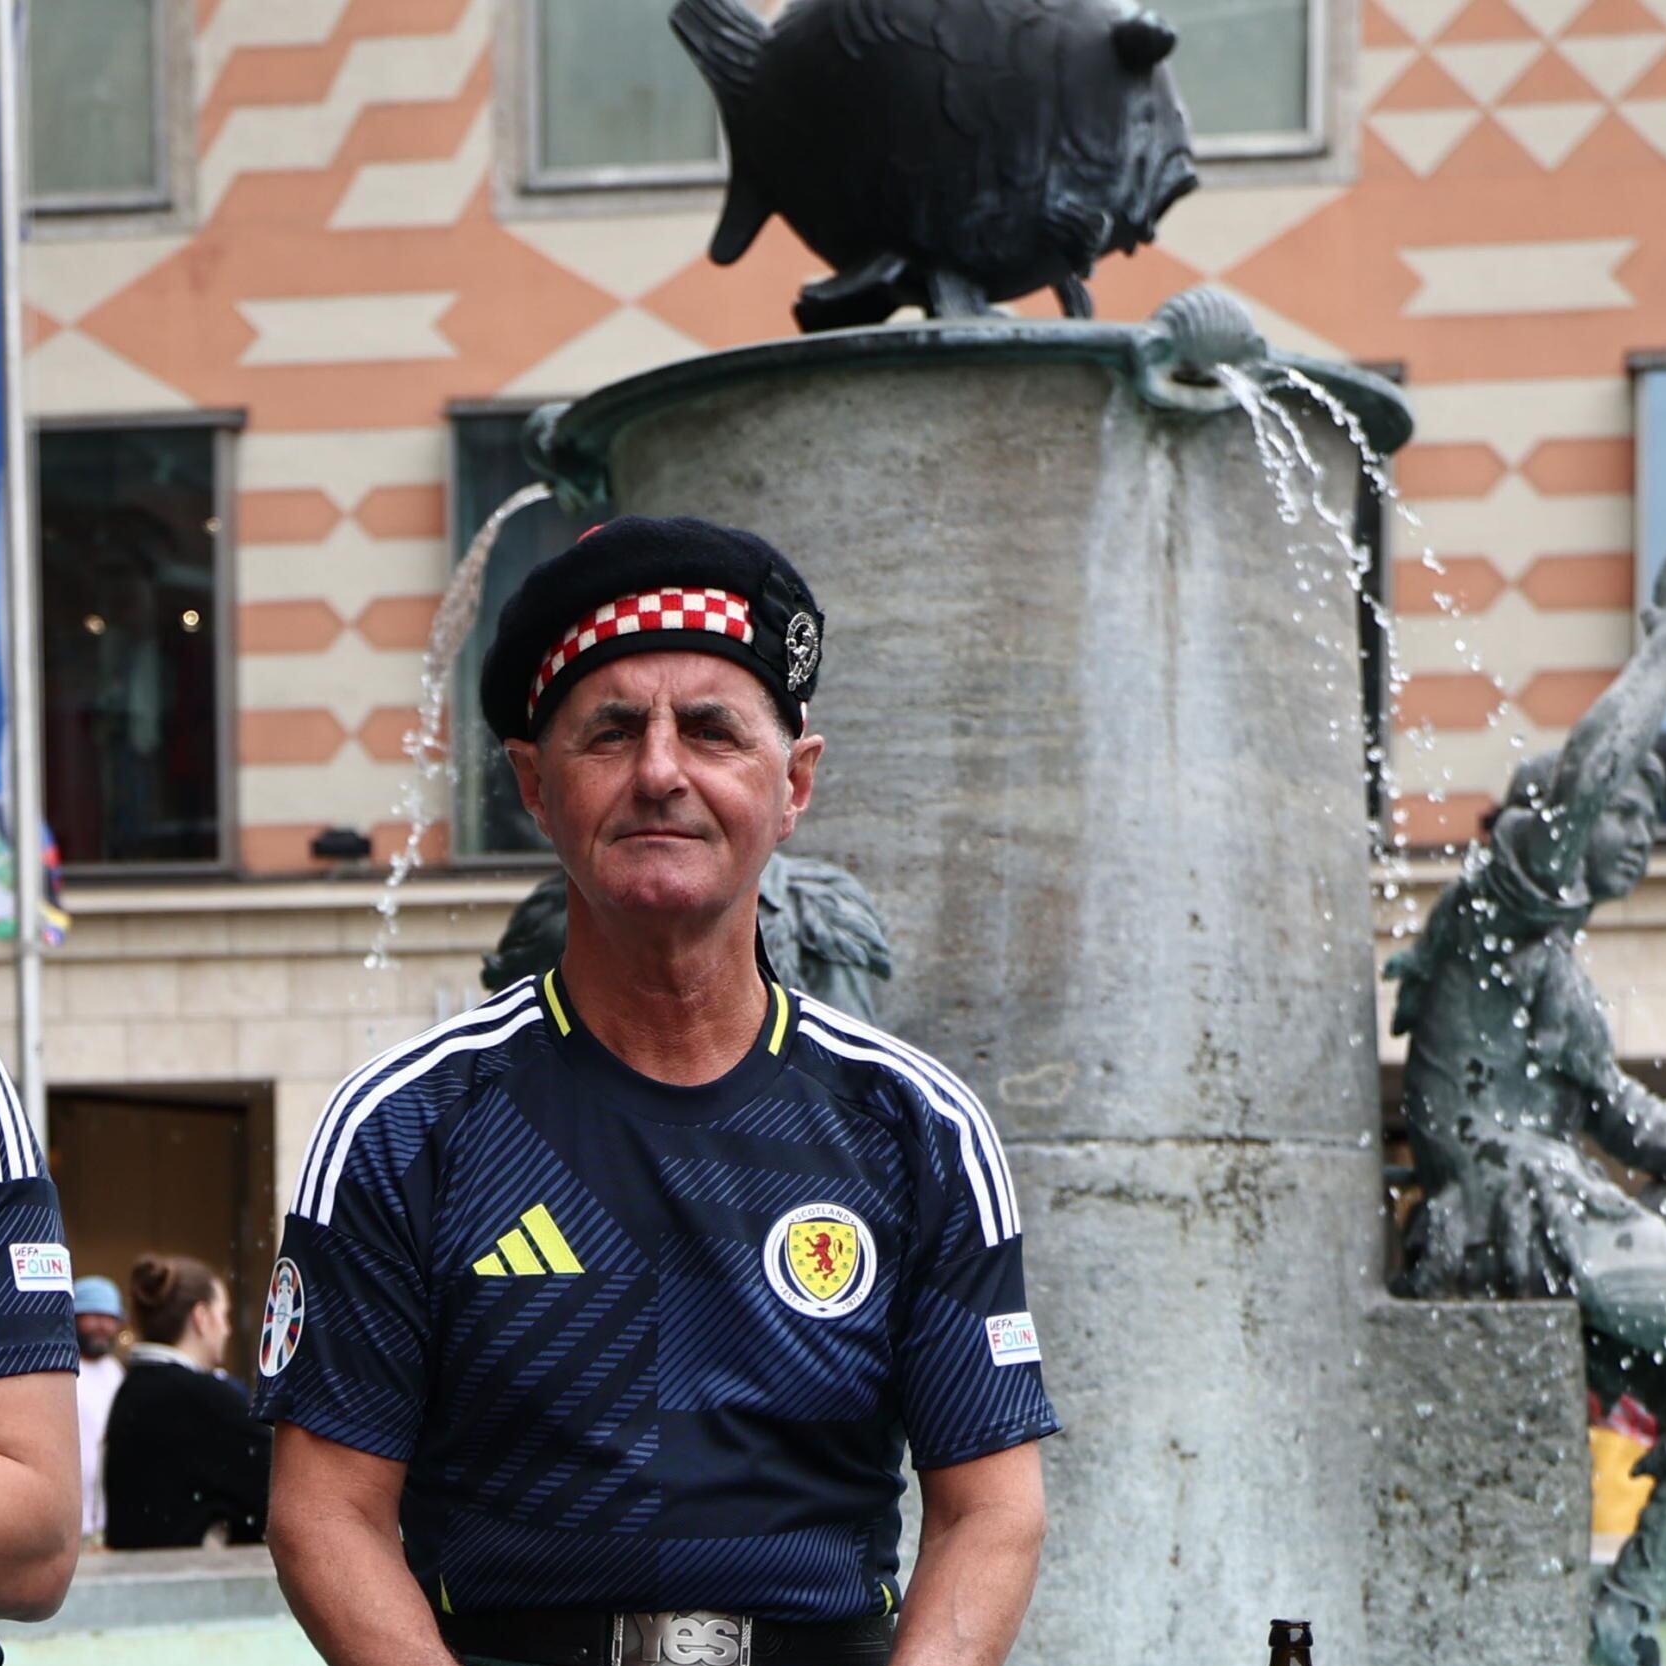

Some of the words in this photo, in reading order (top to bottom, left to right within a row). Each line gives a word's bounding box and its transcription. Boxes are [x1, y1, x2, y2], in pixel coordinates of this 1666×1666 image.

[795, 1206, 851, 1222] SCOTLAND
[14, 1246, 39, 1257] UEFA
[16, 1259, 64, 1275] FOUN
[990, 1318, 1013, 1331] UEFA
[992, 1329, 1033, 1349] FOUN
[634, 1612, 740, 1666] Yes
